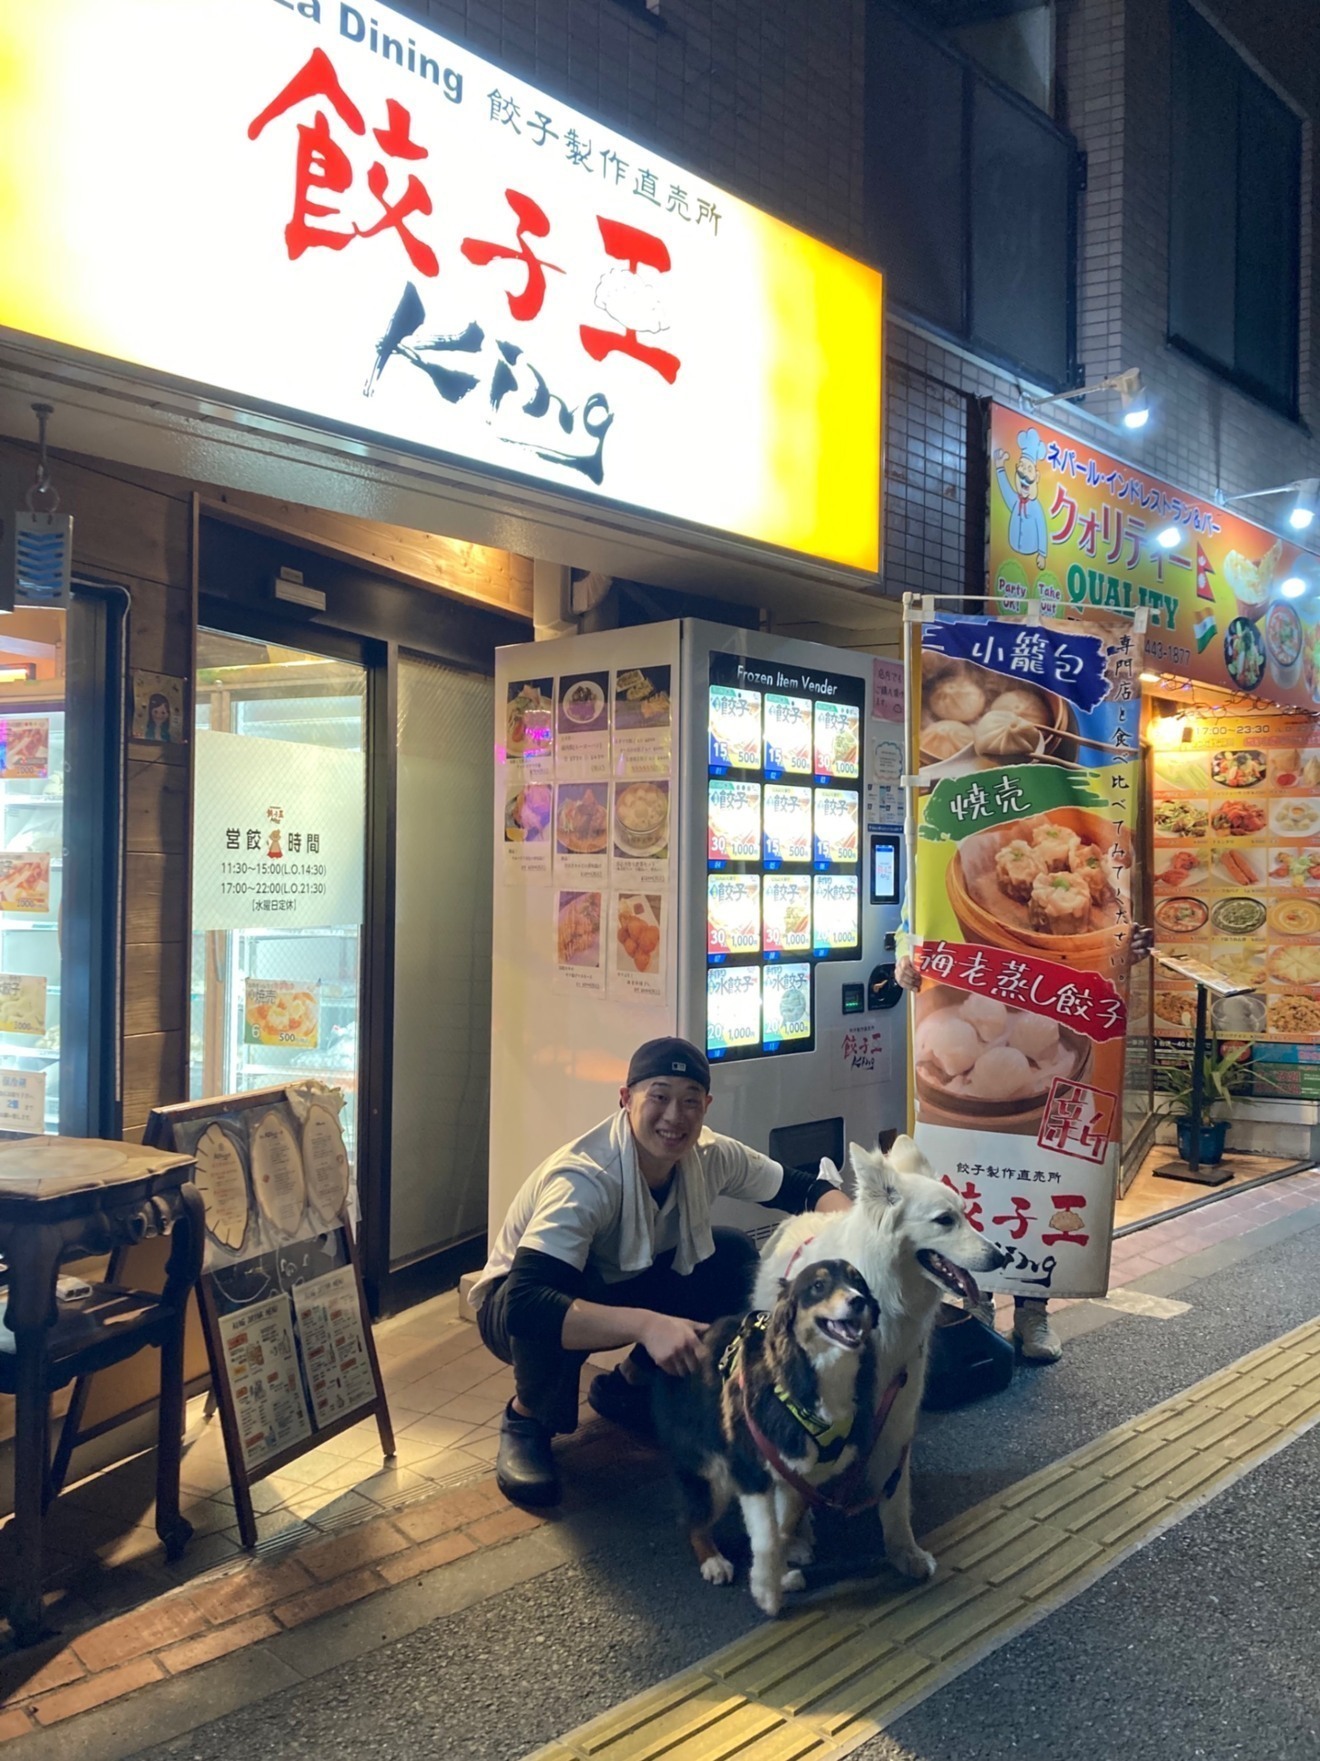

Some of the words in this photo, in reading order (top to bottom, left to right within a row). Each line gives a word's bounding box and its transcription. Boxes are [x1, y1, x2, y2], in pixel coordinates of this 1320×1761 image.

[340, 2, 463, 104] Dining
[487, 88, 722, 236] 餃子製作直売所
[247, 47, 681, 385] 餃子王
[363, 281, 614, 485] King
[1050, 484, 1192, 583] クォリティー
[998, 577, 1027, 598] Party
[1038, 583, 1061, 601] Take
[1066, 563, 1179, 630] QUALITY
[972, 631, 1084, 683] 小籠包
[737, 665, 773, 685] Frozen
[776, 671, 799, 689] Item
[801, 675, 838, 696] Vender
[721, 696, 750, 717] 餃子
[776, 704, 802, 724] 餃子
[825, 711, 849, 733] 餃子
[719, 790, 748, 809] 餃子
[774, 795, 800, 813] 餃子
[824, 798, 848, 816] 餃子
[950, 775, 1031, 821] 焼売
[718, 883, 748, 901] 餃子
[774, 884, 799, 904] 餃子
[920, 940, 1125, 1029] 海老蒸し餃子
[279, 1033, 296, 1042] 500
[956, 1162, 1062, 1184] 餃子製作直売所
[994, 1243, 1057, 1288] ing
